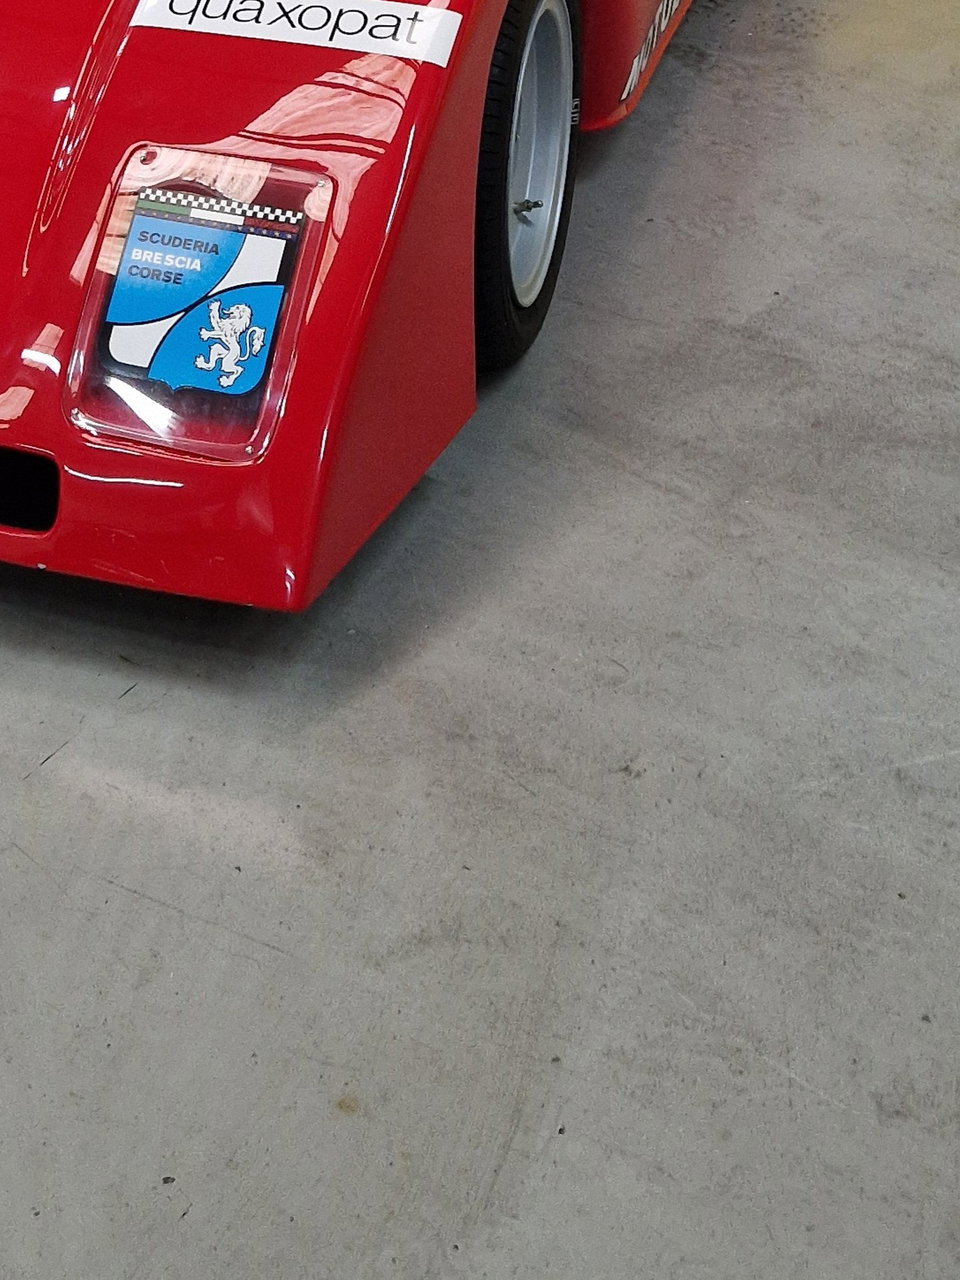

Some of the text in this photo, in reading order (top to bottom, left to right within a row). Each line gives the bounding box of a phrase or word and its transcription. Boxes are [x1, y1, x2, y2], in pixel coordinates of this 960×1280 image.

[137, 229, 220, 257] SCUDERIA
[131, 248, 202, 273] BRESCIA
[127, 264, 184, 286] CORSE
